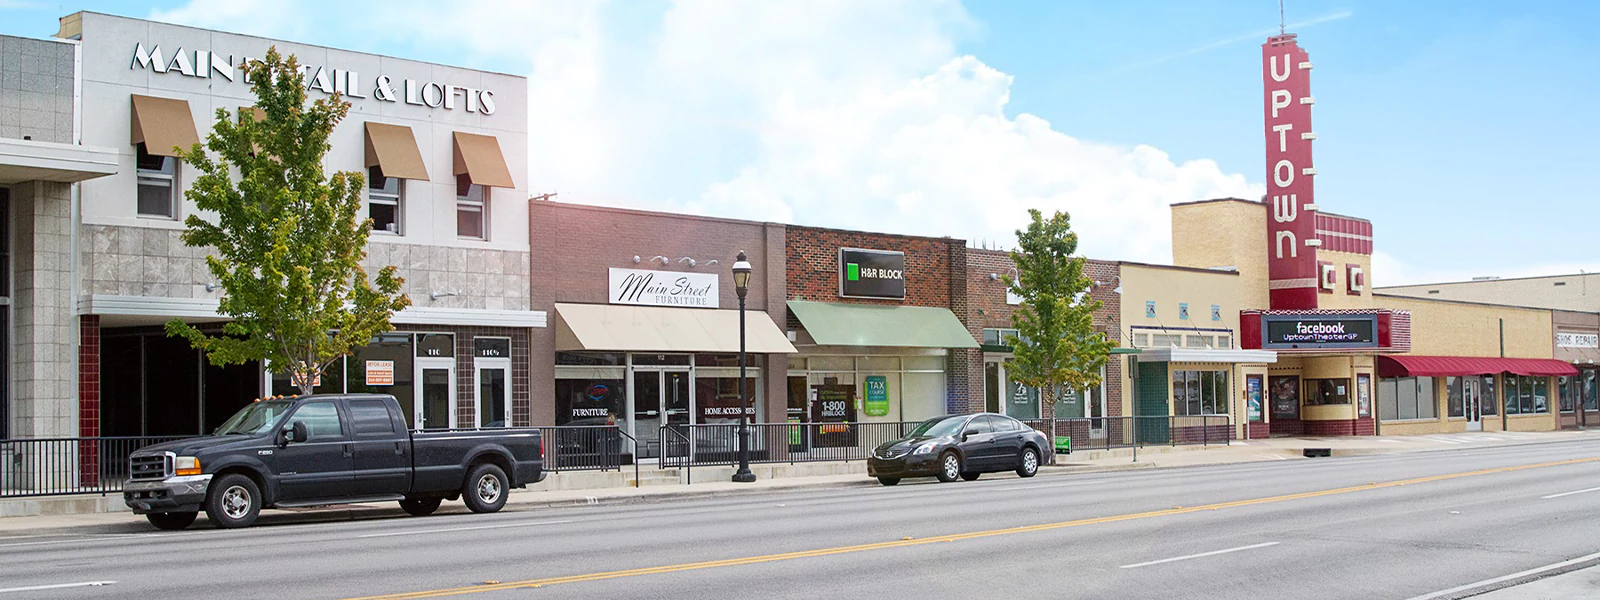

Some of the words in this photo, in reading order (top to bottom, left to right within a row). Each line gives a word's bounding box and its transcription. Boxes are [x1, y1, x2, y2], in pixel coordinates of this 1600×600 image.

[131, 42, 233, 82] MAIN
[374, 76, 397, 102] &
[405, 79, 496, 115] LOFTS
[1270, 53, 1298, 258] UPTOWN
[861, 268, 878, 278] H&R
[879, 269, 903, 280] BLOCK
[619, 273, 667, 302] Main
[670, 277, 712, 296] Street
[656, 295, 707, 306] FURNITURE
[1297, 322, 1345, 333] facebook
[822, 401, 846, 411] 1-800
[573, 409, 609, 417] FURNITURE
